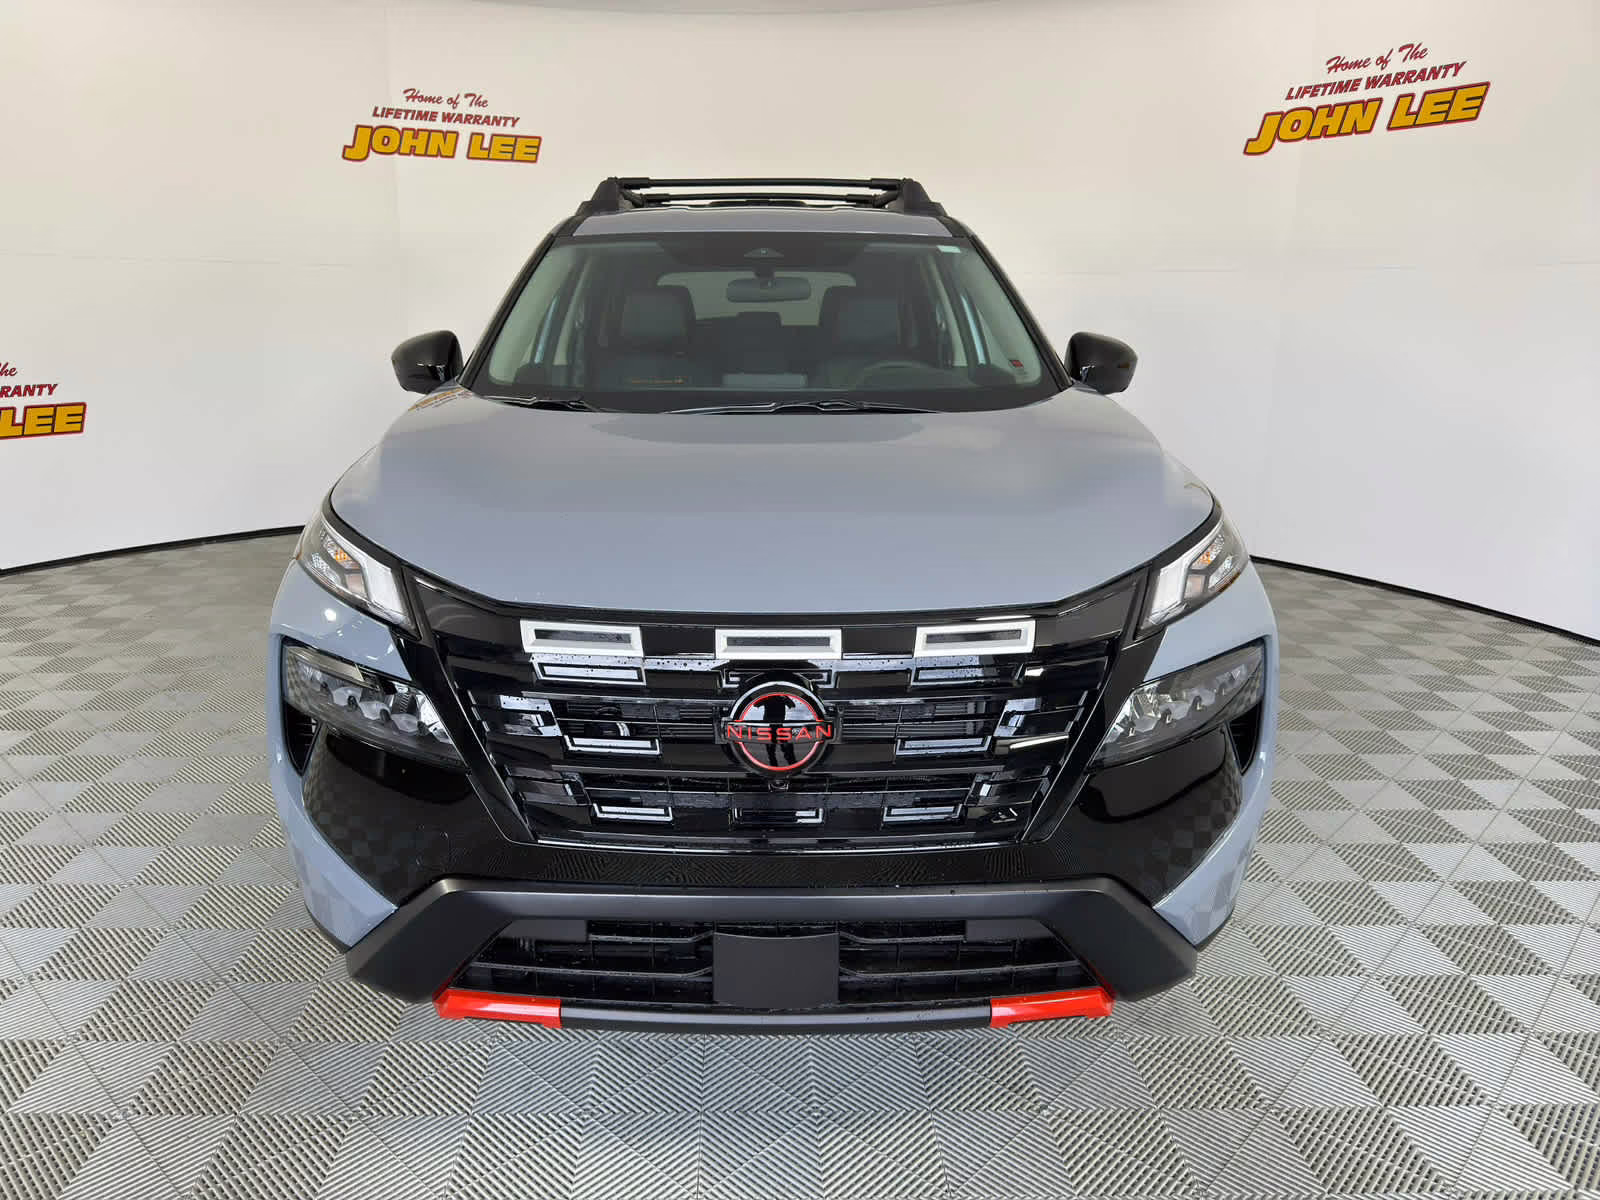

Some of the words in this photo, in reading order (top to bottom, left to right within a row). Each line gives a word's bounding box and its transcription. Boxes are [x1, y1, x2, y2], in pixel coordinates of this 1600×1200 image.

[1326, 55, 1371, 74] Home
[1375, 49, 1394, 71] of
[1398, 42, 1428, 63] The
[1285, 78, 1362, 101] LIFETIME
[1364, 61, 1467, 91] WARRANTY
[403, 87, 443, 105] Home
[446, 93, 460, 109] of
[463, 93, 489, 108] The
[372, 106, 438, 122] LIFETIME
[441, 111, 520, 127] WARRANTY
[1243, 97, 1384, 156] JOHN
[1386, 81, 1491, 132] LEE
[342, 124, 459, 162] JOHN
[466, 132, 542, 164] LEE
[0, 362, 18, 376] he
[0, 384, 58, 398] RANTY
[0, 402, 87, 440] LEE
[727, 724, 833, 741] NISSAN
